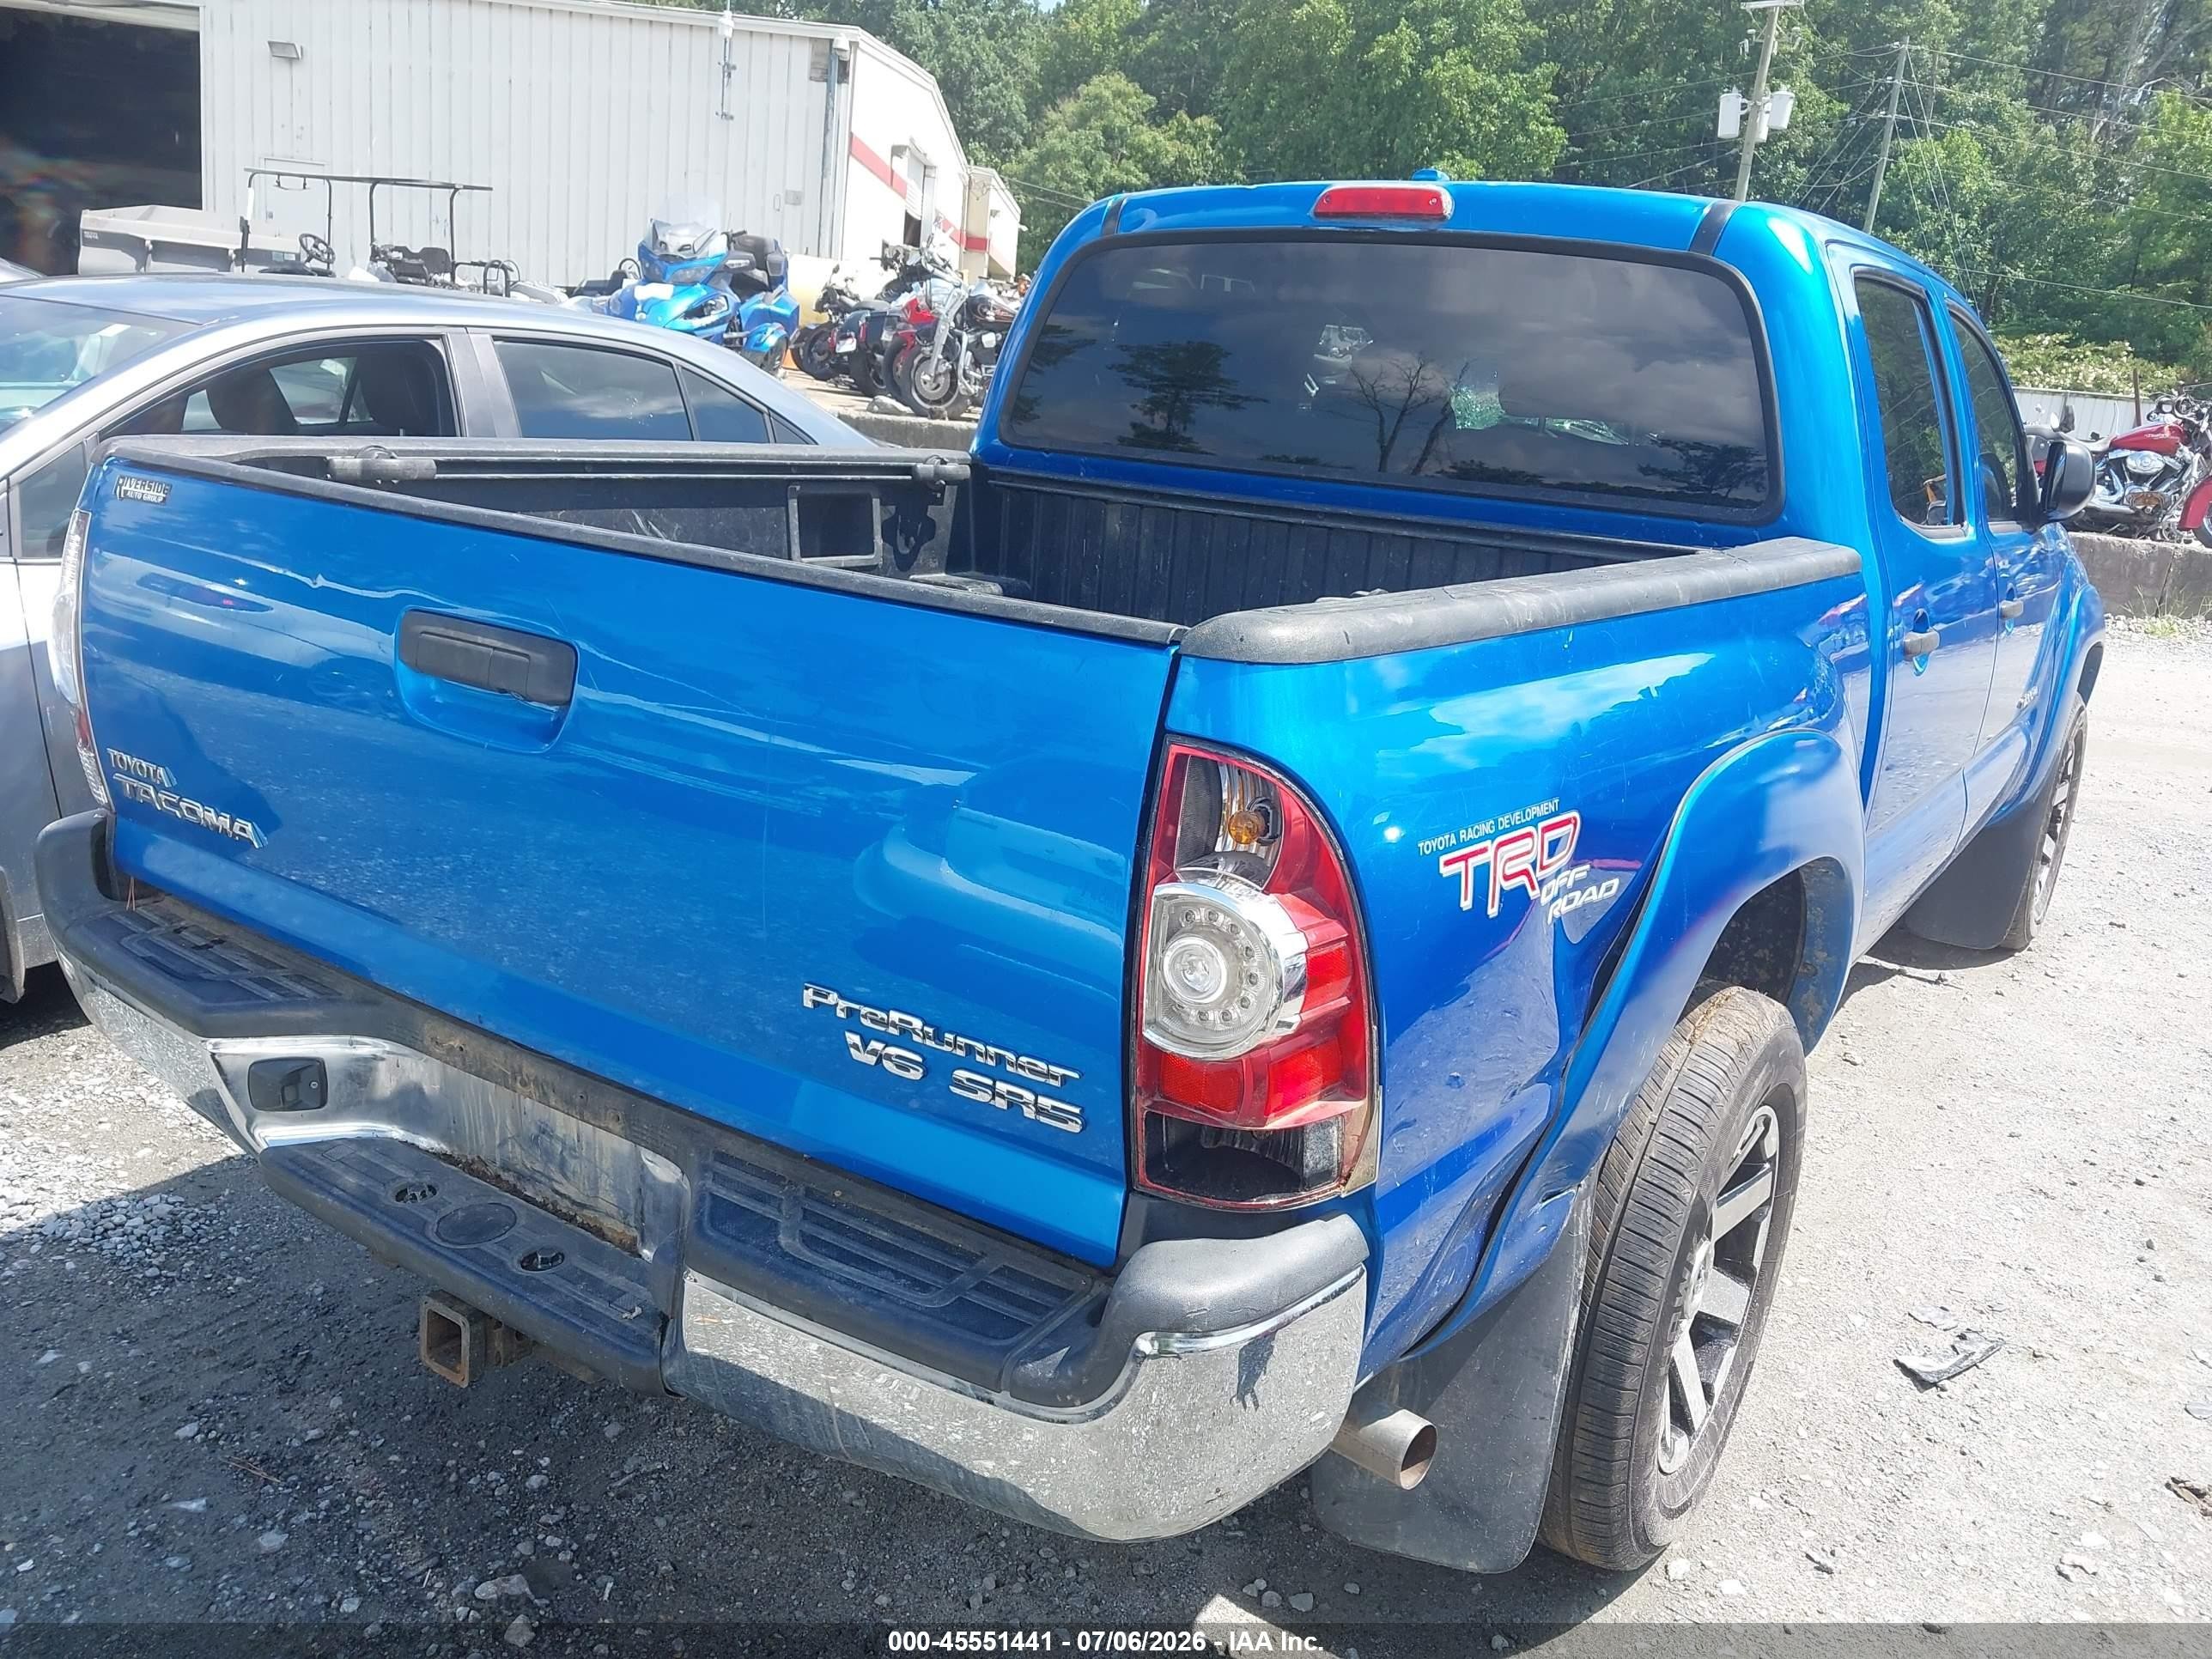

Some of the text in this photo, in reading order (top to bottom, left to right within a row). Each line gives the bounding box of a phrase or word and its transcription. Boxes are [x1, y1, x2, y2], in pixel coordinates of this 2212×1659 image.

[113, 475, 171, 500] RIVERSIDE
[126, 489, 165, 504] AUTO GROUP
[106, 748, 174, 787] TOYOTA
[112, 773, 265, 848] TACOMA
[1418, 798, 1559, 856] TOYOTA RACING DEVELOPMENT
[1439, 811, 1581, 919] TRD
[1539, 864, 1591, 906] OFF
[1547, 878, 1620, 925] ROAD
[803, 982, 1083, 1087] PreRunner
[844, 1030, 1086, 1133] V6 SR5
